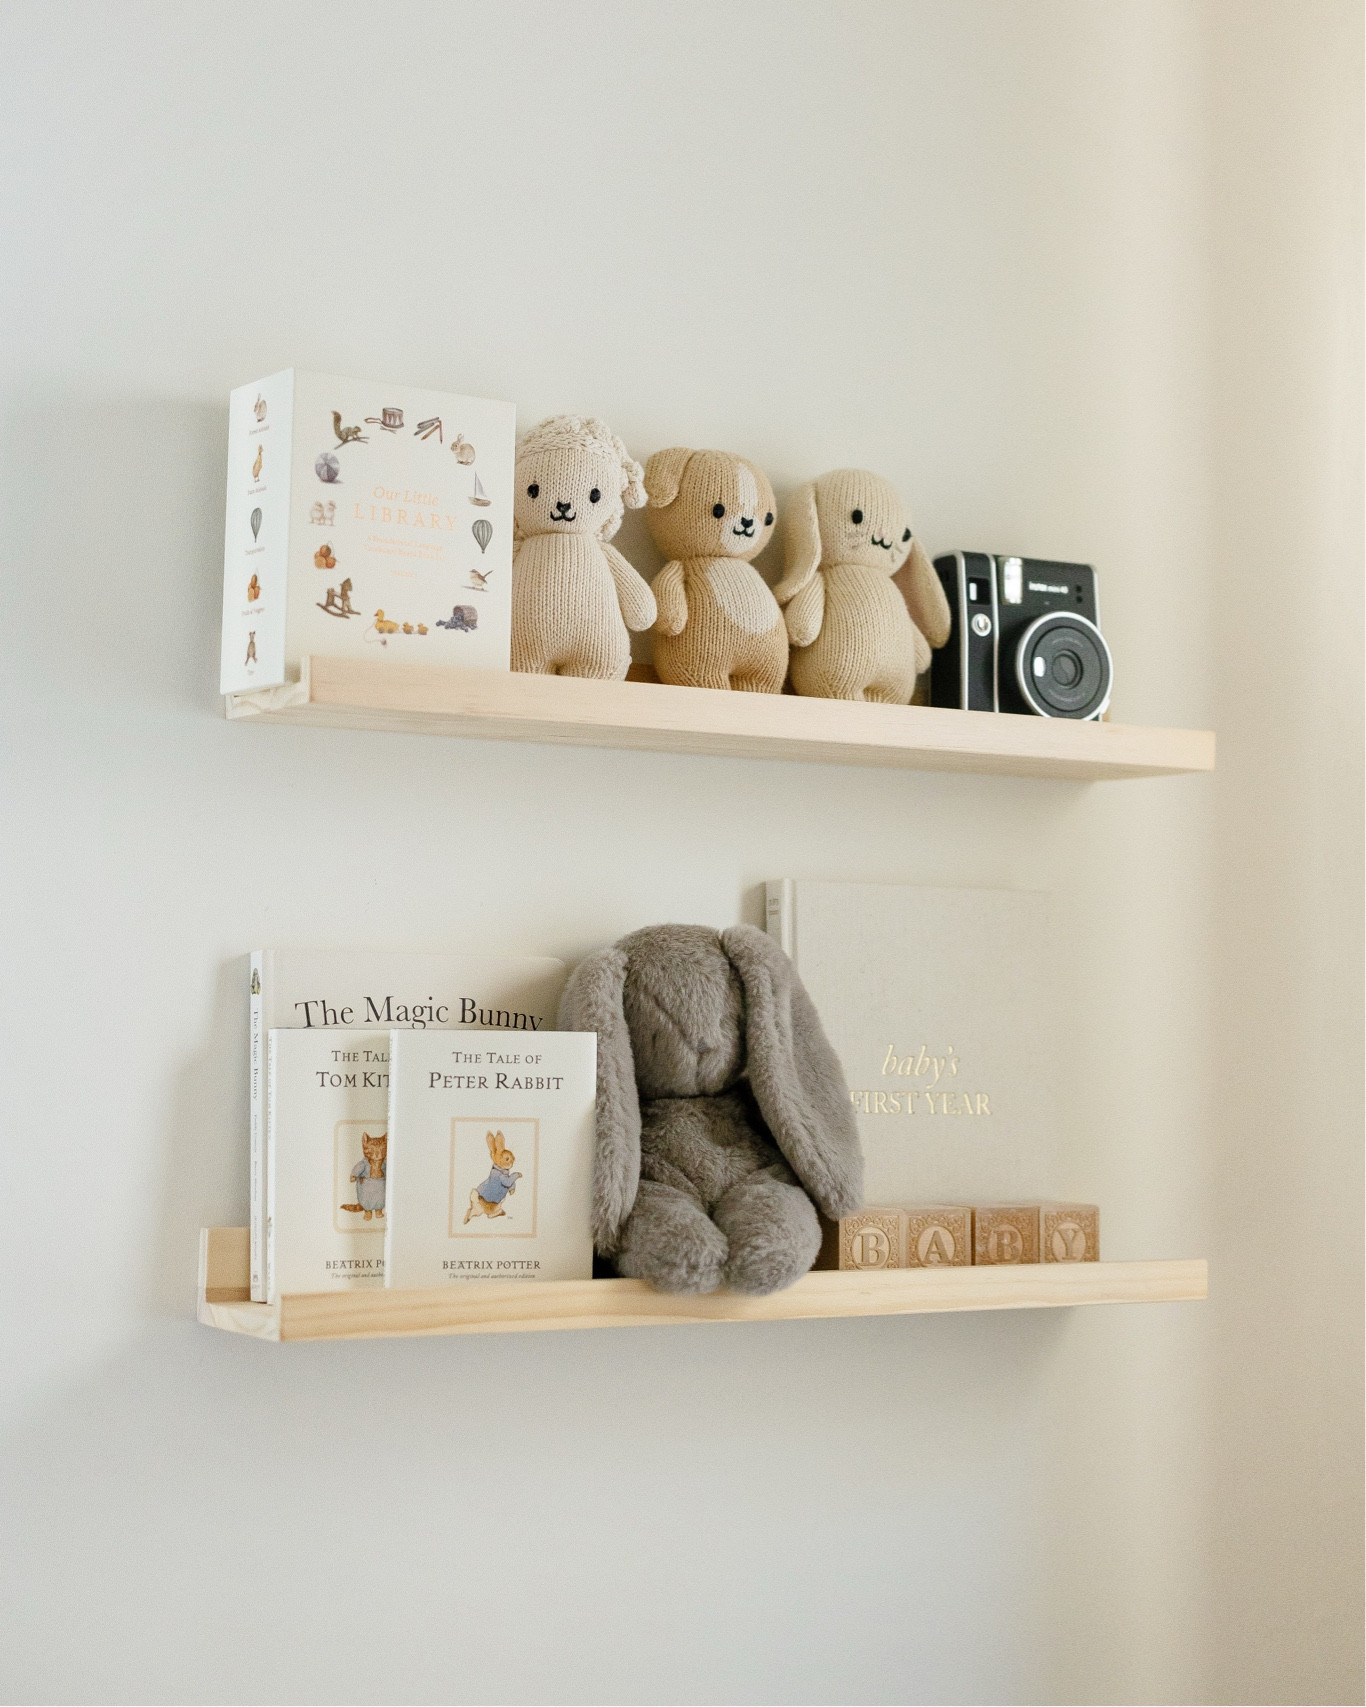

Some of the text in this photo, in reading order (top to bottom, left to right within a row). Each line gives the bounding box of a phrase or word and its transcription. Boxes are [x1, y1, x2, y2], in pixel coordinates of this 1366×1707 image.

[373, 486, 439, 506] Our Little
[354, 502, 457, 531] LIBRARY
[294, 995, 544, 1032] The Magic Bunny
[251, 1010, 260, 1101] The Magic Bunny
[331, 1050, 389, 1062] THE TAL
[452, 1051, 542, 1065] THE TALE OF
[881, 1043, 960, 1090] baby's
[316, 1071, 357, 1088] TOM
[428, 1071, 564, 1090] PETER RABBIT
[849, 1090, 993, 1116] FIRST YEAR
[325, 1260, 372, 1270] BEATRIX
[442, 1260, 541, 1270] BEATRIX POTTER
